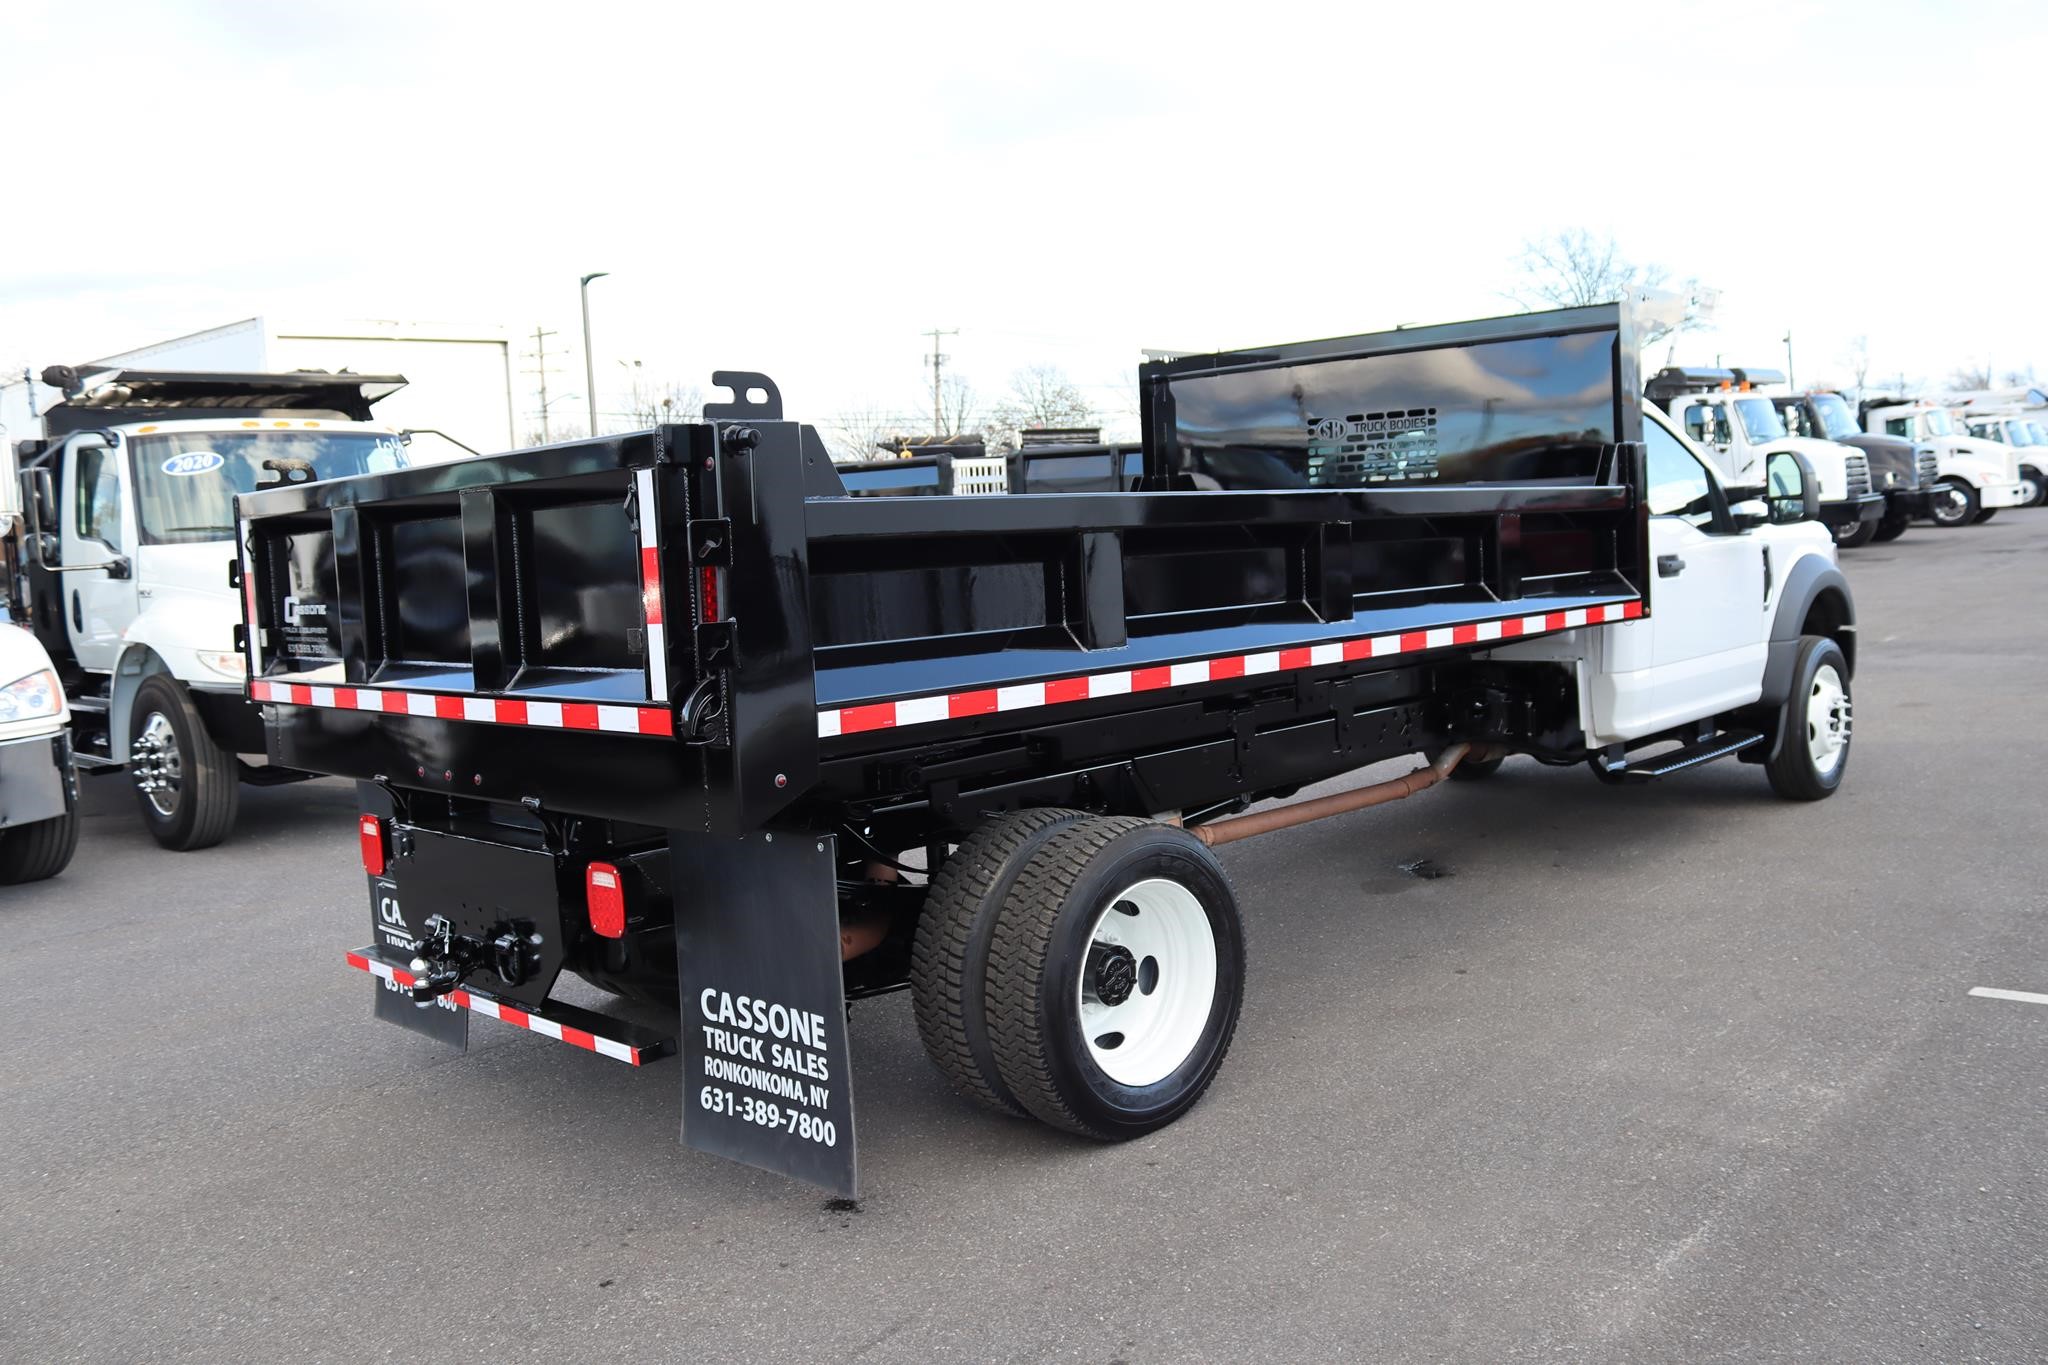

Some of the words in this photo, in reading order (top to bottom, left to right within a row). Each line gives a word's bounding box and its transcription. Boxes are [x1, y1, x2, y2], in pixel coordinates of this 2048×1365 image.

[1354, 421, 1387, 433] TRUCK
[1390, 417, 1427, 431] BODIES
[173, 455, 214, 473] 2020
[700, 988, 827, 1051] CASSONE
[702, 1025, 766, 1063] TRUCK
[771, 1044, 829, 1081] SALES
[704, 1056, 809, 1107] RONKONKOMA,
[810, 1084, 829, 1110] NY
[700, 1086, 836, 1147] 631-389-7800
